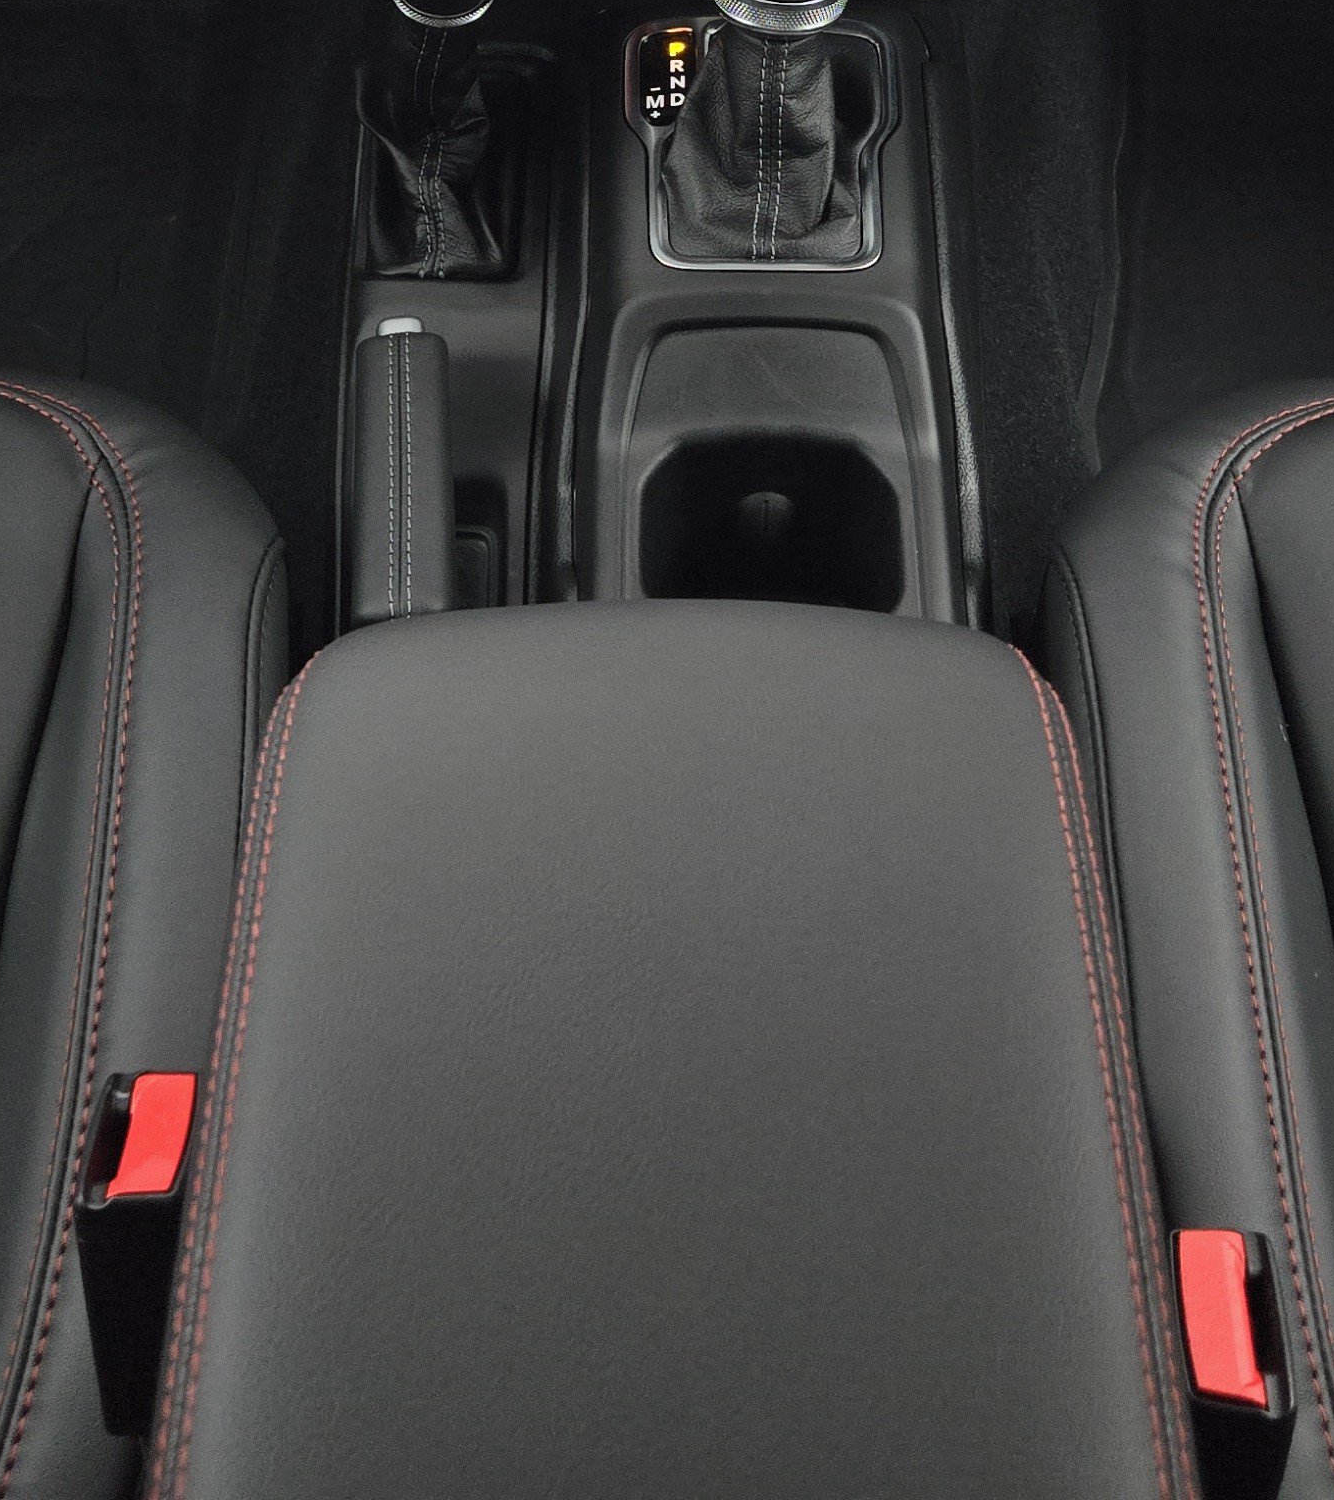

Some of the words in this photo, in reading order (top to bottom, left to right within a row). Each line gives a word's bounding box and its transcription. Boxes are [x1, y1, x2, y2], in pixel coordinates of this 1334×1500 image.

[669, 42, 686, 57] P
[670, 60, 685, 73] R
[670, 75, 686, 89] N
[646, 95, 665, 109] M
[670, 93, 686, 107] D
